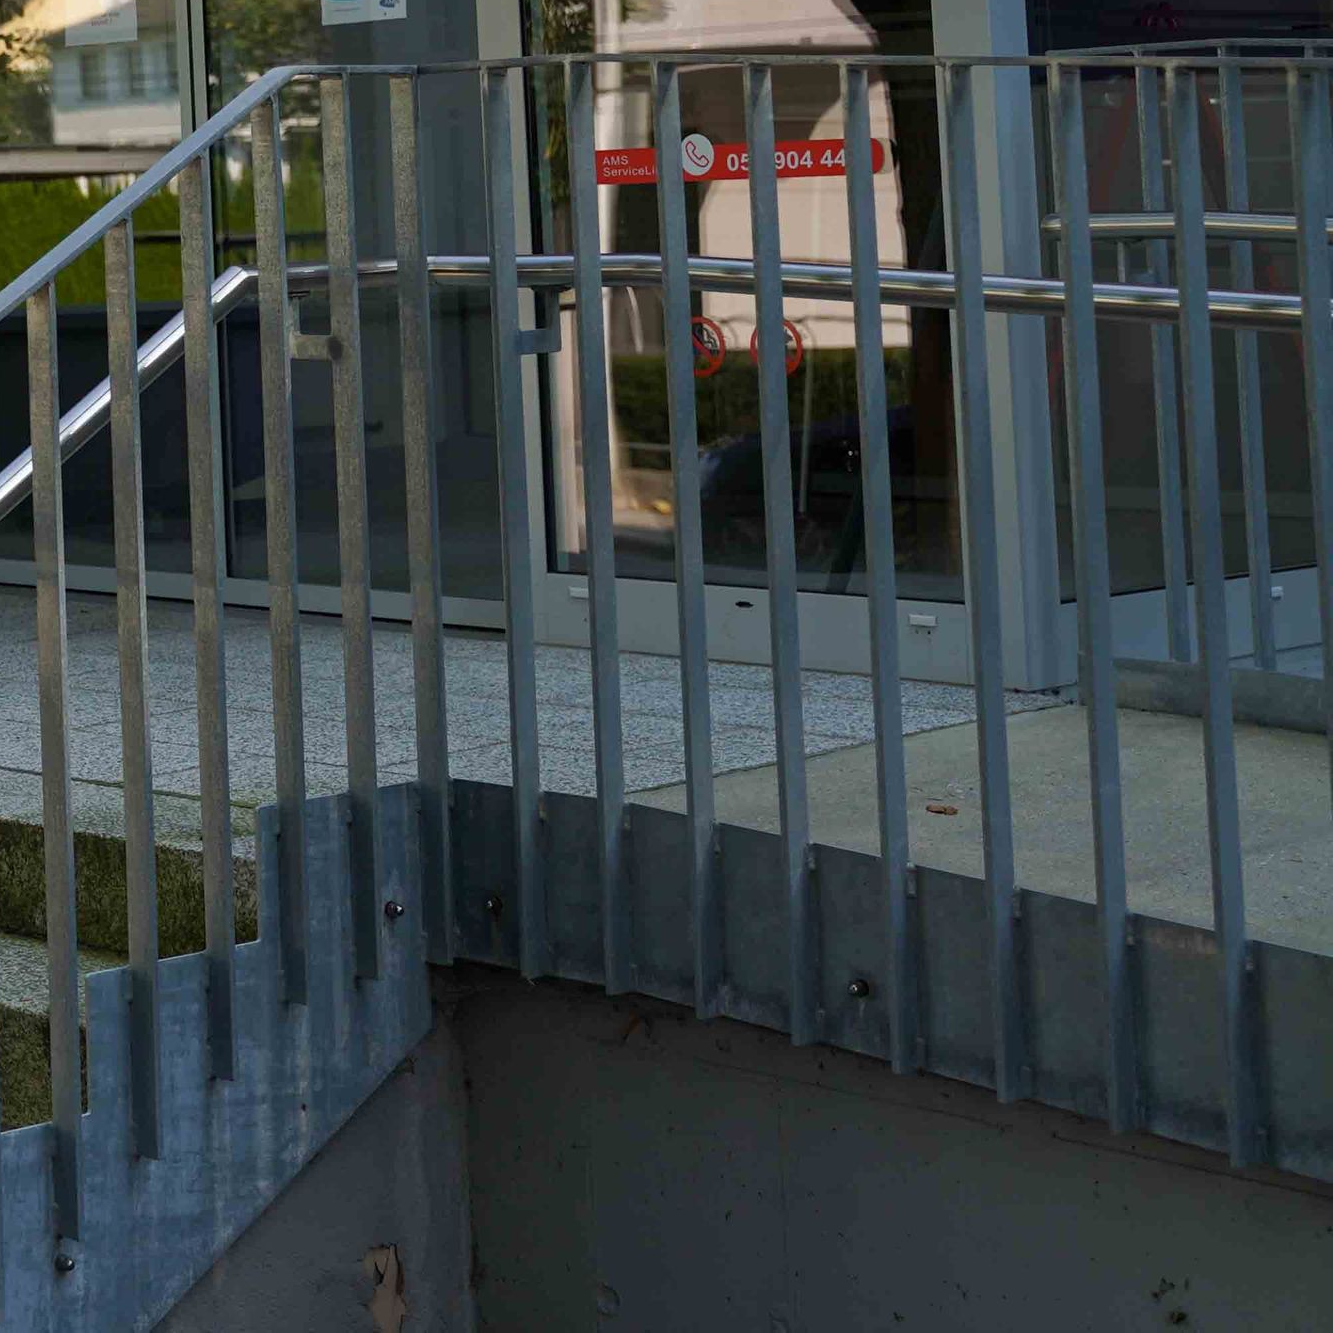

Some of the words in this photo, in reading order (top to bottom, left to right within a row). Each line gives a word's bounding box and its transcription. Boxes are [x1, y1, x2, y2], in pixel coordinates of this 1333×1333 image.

[602, 155, 629, 166] AMS
[727, 153, 750, 171] 05
[774, 150, 813, 170] 904
[820, 149, 846, 168] 44
[602, 166, 656, 177] ServiceLi
